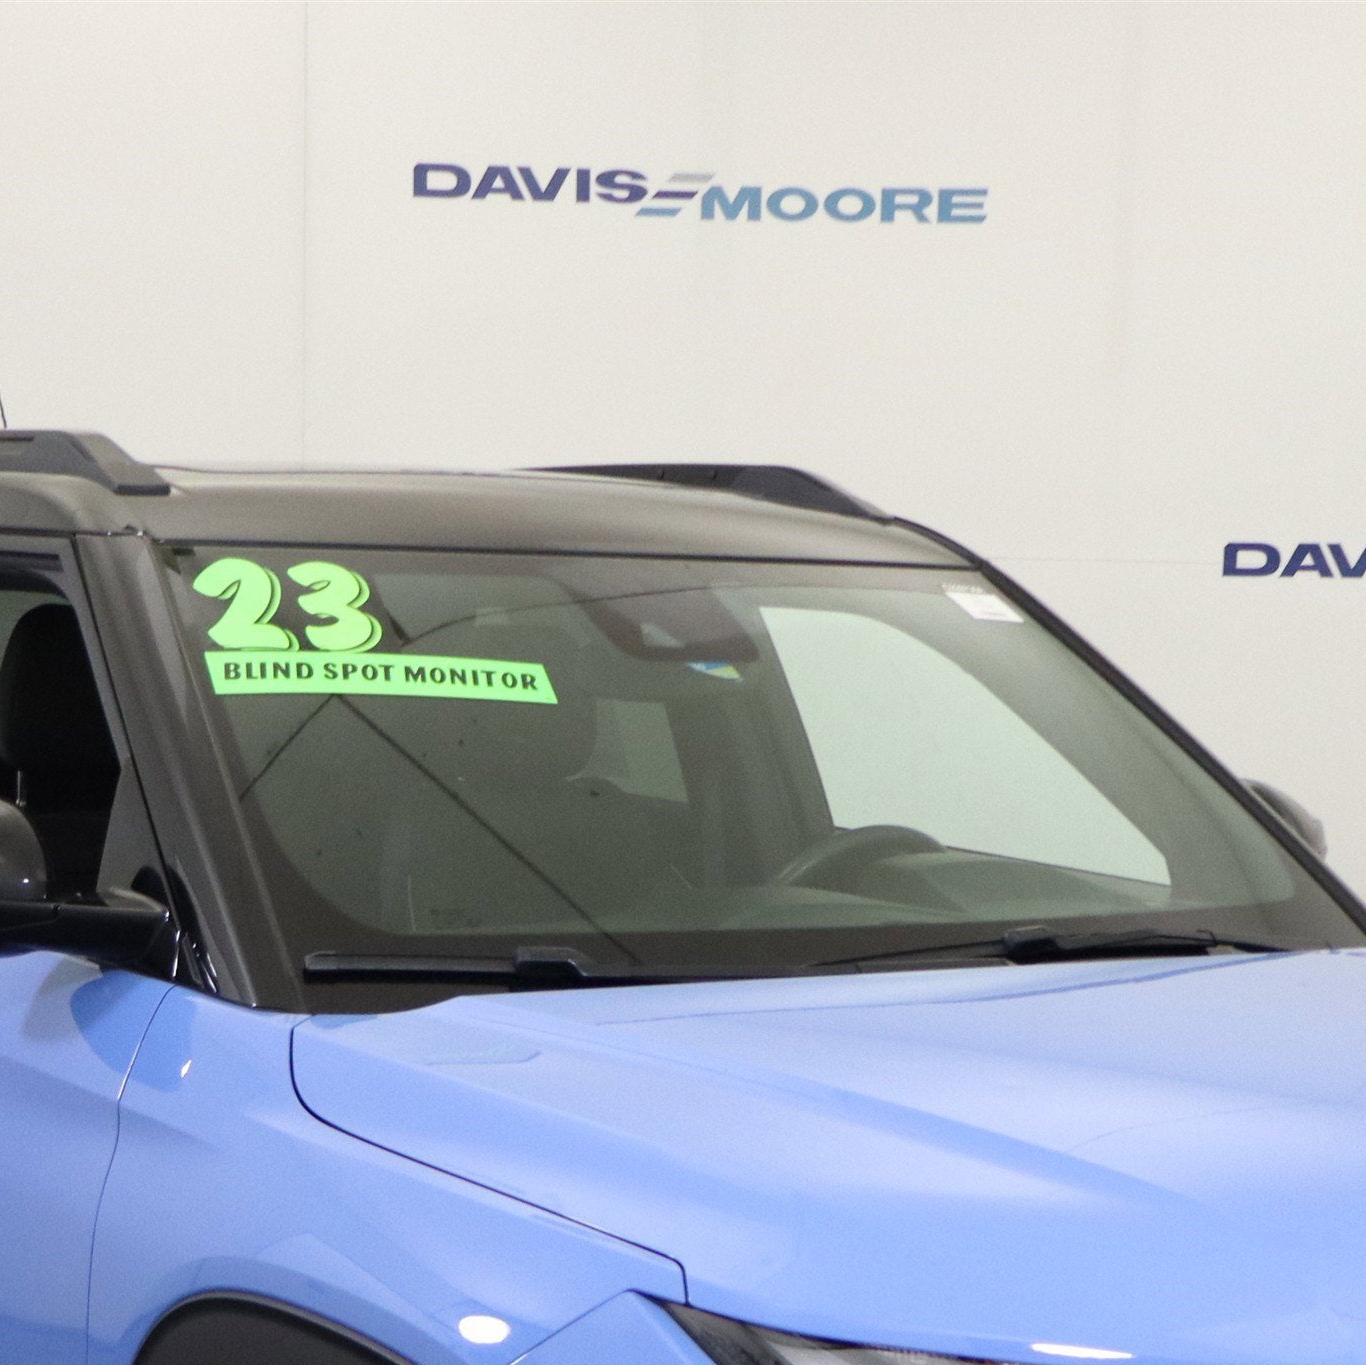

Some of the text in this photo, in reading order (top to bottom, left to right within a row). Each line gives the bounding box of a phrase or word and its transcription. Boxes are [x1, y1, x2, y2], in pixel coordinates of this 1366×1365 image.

[412, 162, 989, 224] DAVIS MOORE
[192, 557, 383, 653] 23
[223, 662, 539, 691] BLIND SPOT MONITOR
